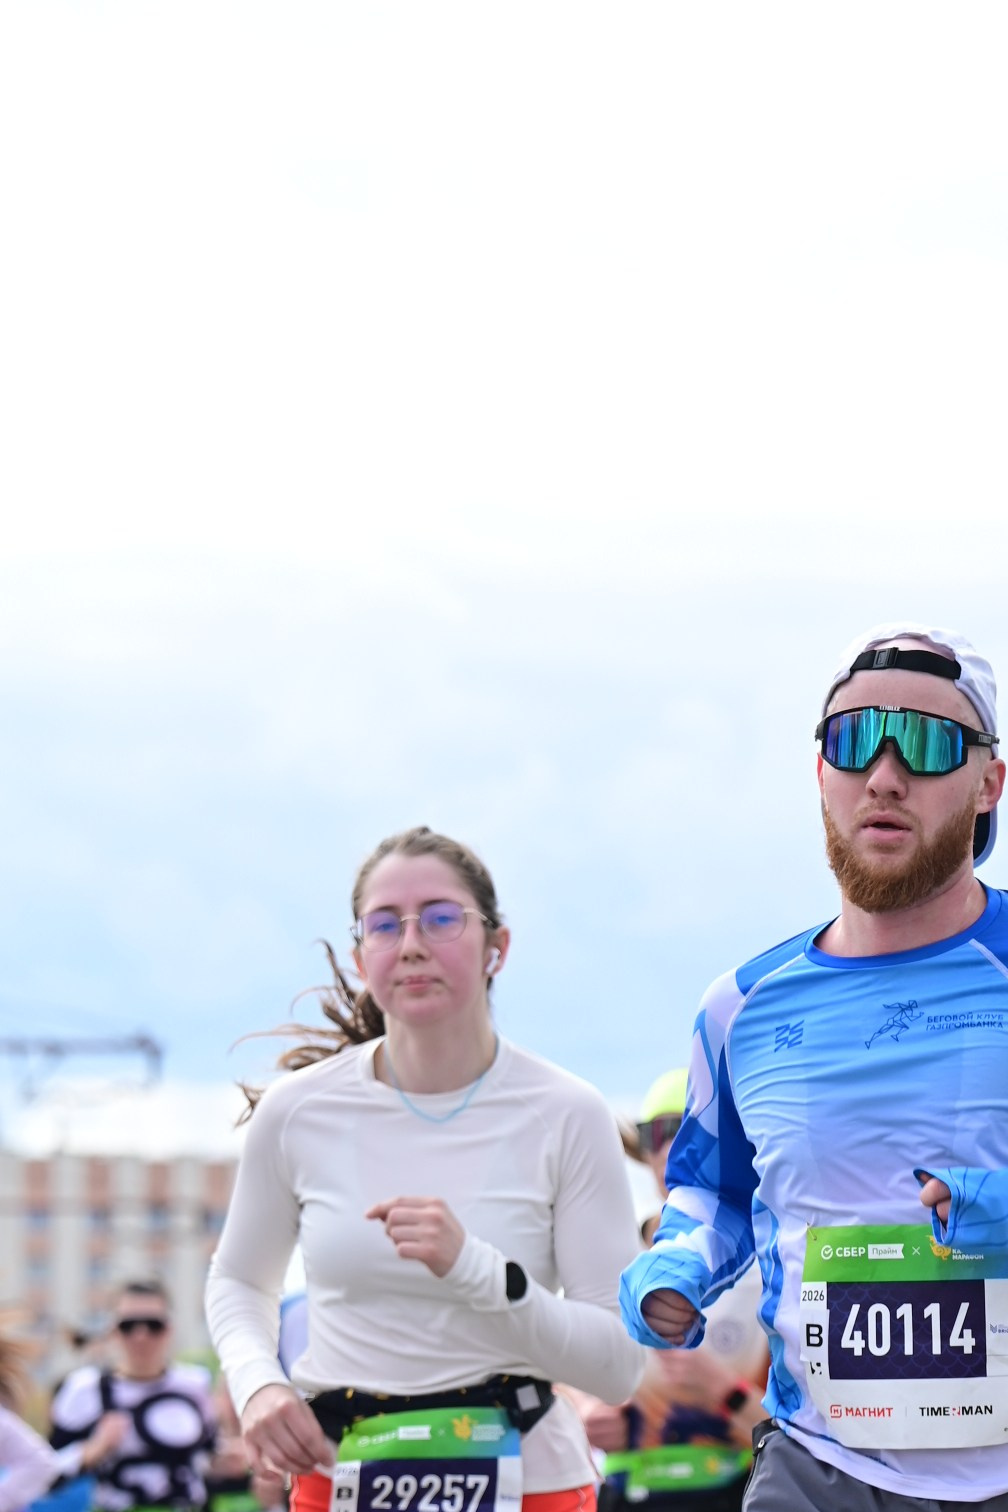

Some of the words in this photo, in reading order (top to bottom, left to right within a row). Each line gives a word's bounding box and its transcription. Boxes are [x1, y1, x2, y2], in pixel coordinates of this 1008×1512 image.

[927, 1011, 973, 1024] БЕГОВОЙ
[835, 1246, 866, 1258] СБЕР
[872, 1247, 898, 1256] Прайм
[802, 1290, 825, 1302] 2026
[841, 1302, 976, 1357] 40114
[805, 1324, 824, 1348] B
[845, 1406, 894, 1418] МАГНИТ
